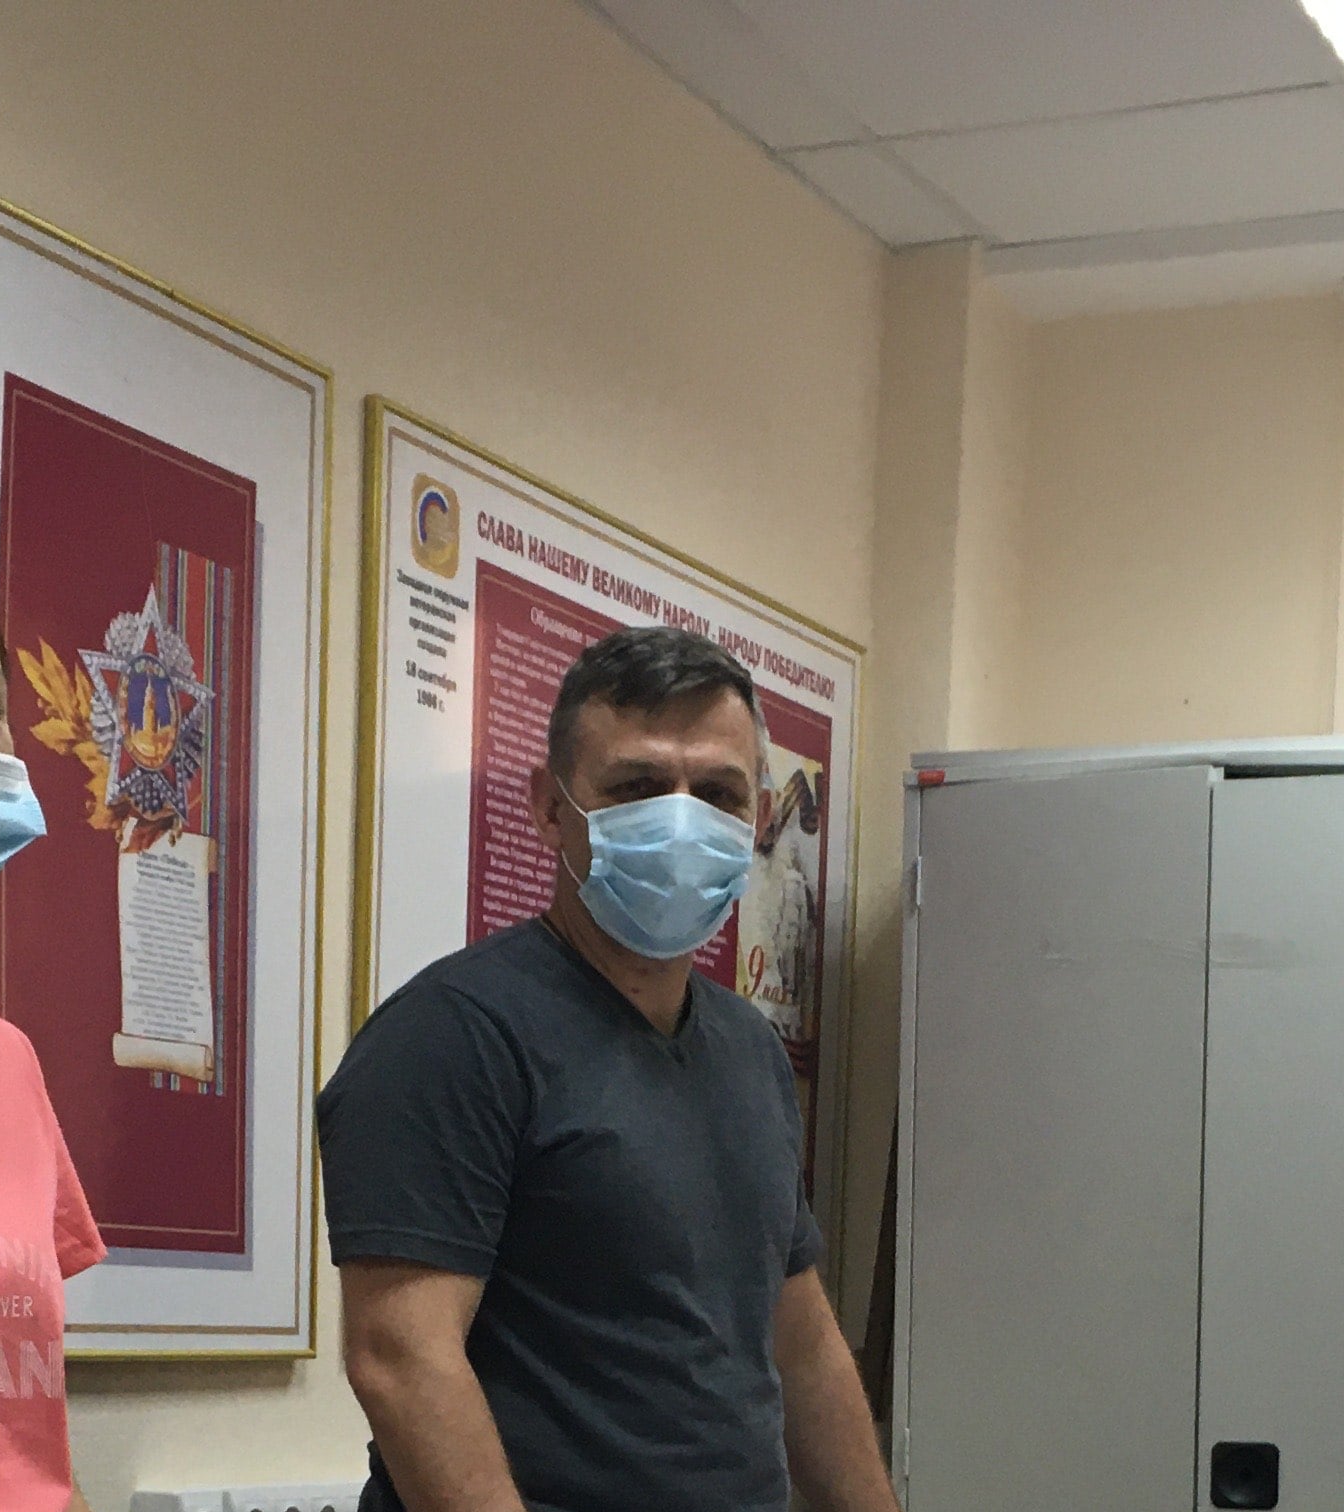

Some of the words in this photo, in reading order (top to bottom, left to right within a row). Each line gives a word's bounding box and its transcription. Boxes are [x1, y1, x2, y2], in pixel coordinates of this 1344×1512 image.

[477, 510, 525, 559] СЛАВА
[528, 534, 590, 586] НАШЕМУ
[593, 565, 662, 620] ВЕЛИКОМУ
[743, 945, 764, 998] 9
